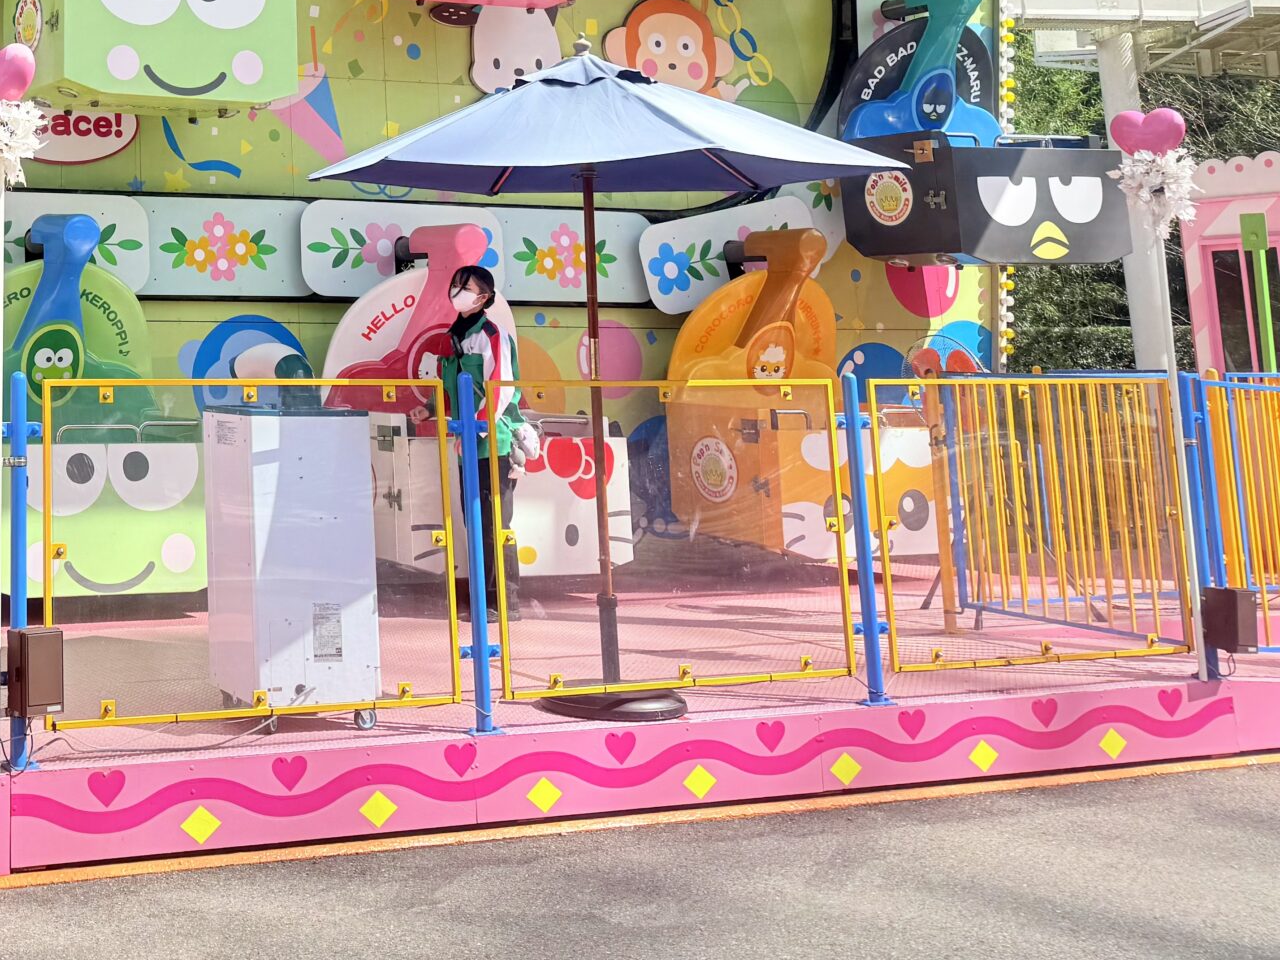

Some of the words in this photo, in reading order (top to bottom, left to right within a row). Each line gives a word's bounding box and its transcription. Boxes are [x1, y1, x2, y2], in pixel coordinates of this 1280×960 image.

[861, 66, 886, 101] BAD
[885, 41, 917, 67] BAD
[956, 44, 981, 103] Z-MARU
[361, 294, 416, 342] HELLO
[695, 294, 754, 354] COROCORO
